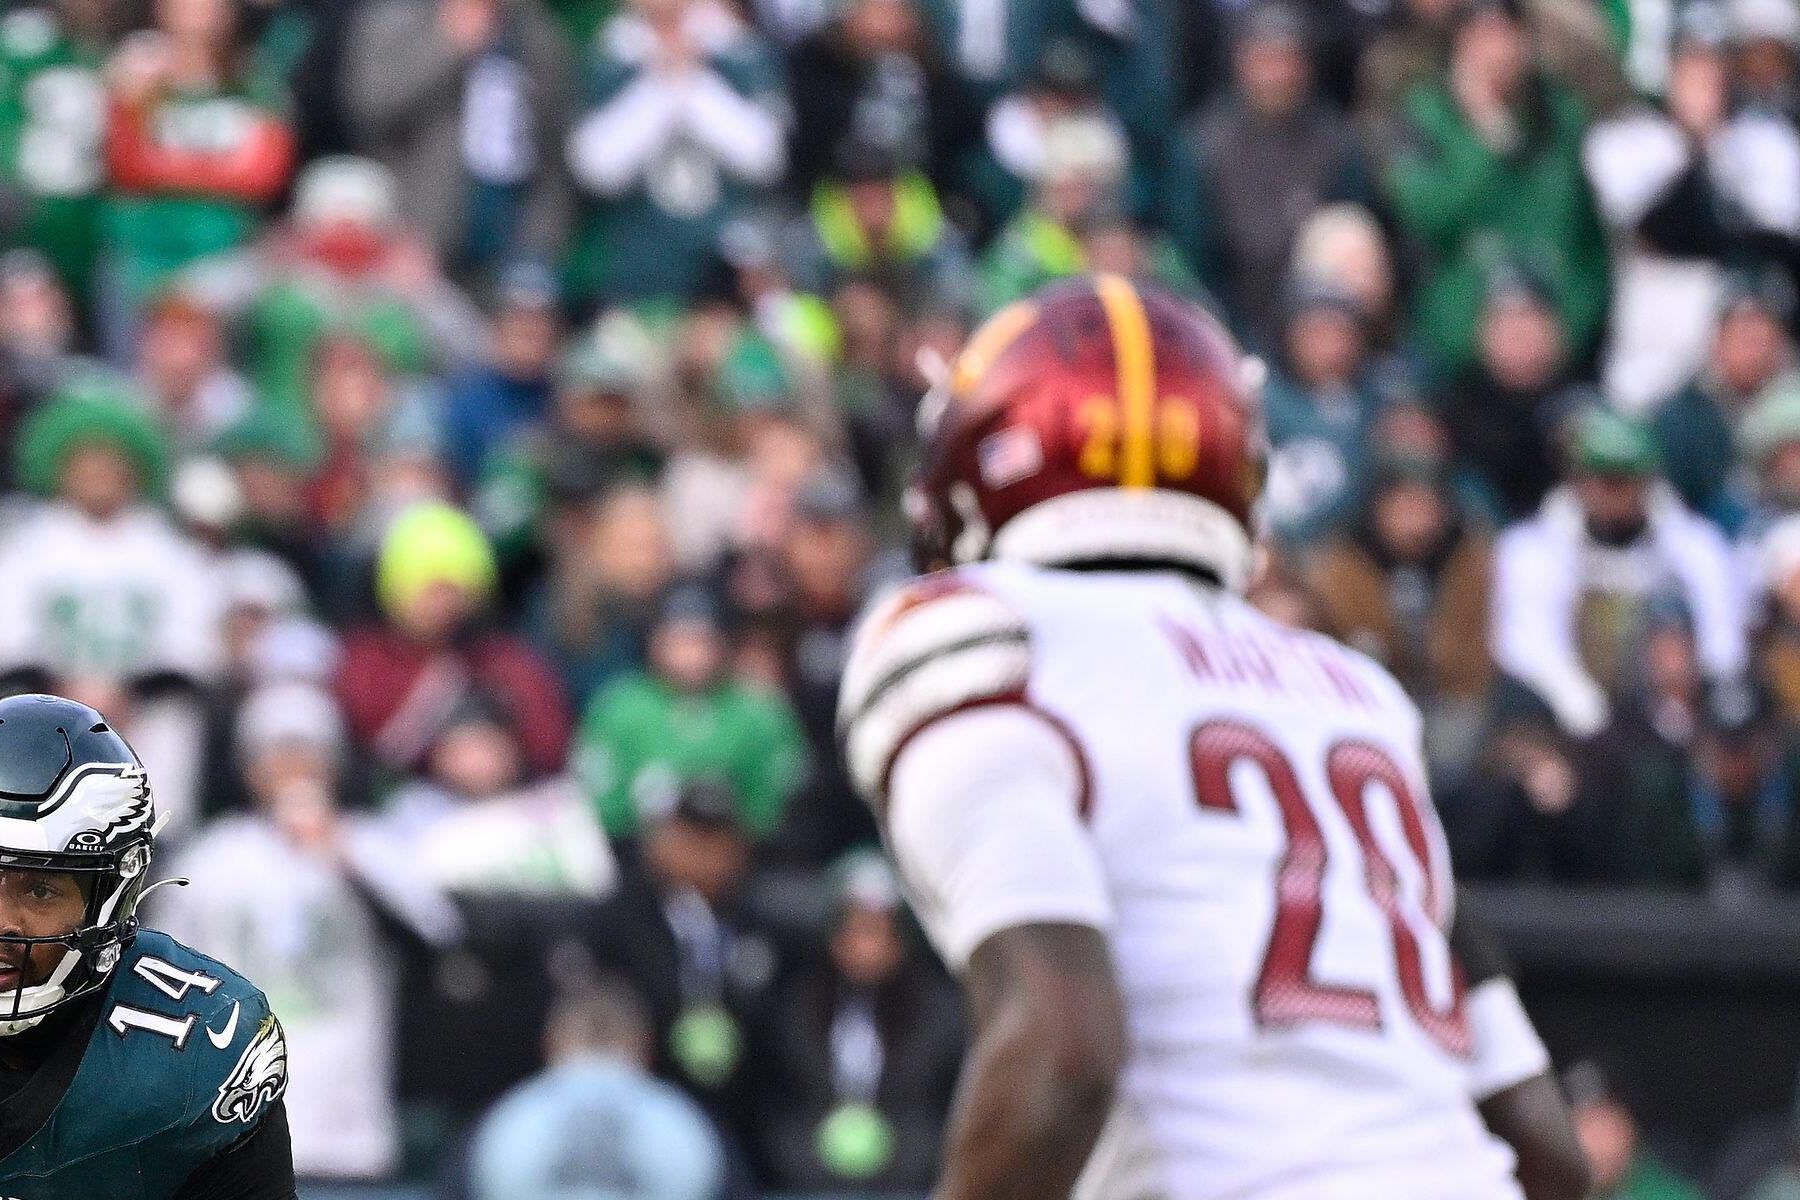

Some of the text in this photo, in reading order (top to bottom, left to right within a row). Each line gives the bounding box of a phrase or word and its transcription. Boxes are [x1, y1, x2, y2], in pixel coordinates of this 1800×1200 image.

[68, 843, 106, 852] OAKLEY
[1189, 718, 1477, 1058] 20
[107, 955, 223, 1049] 14
